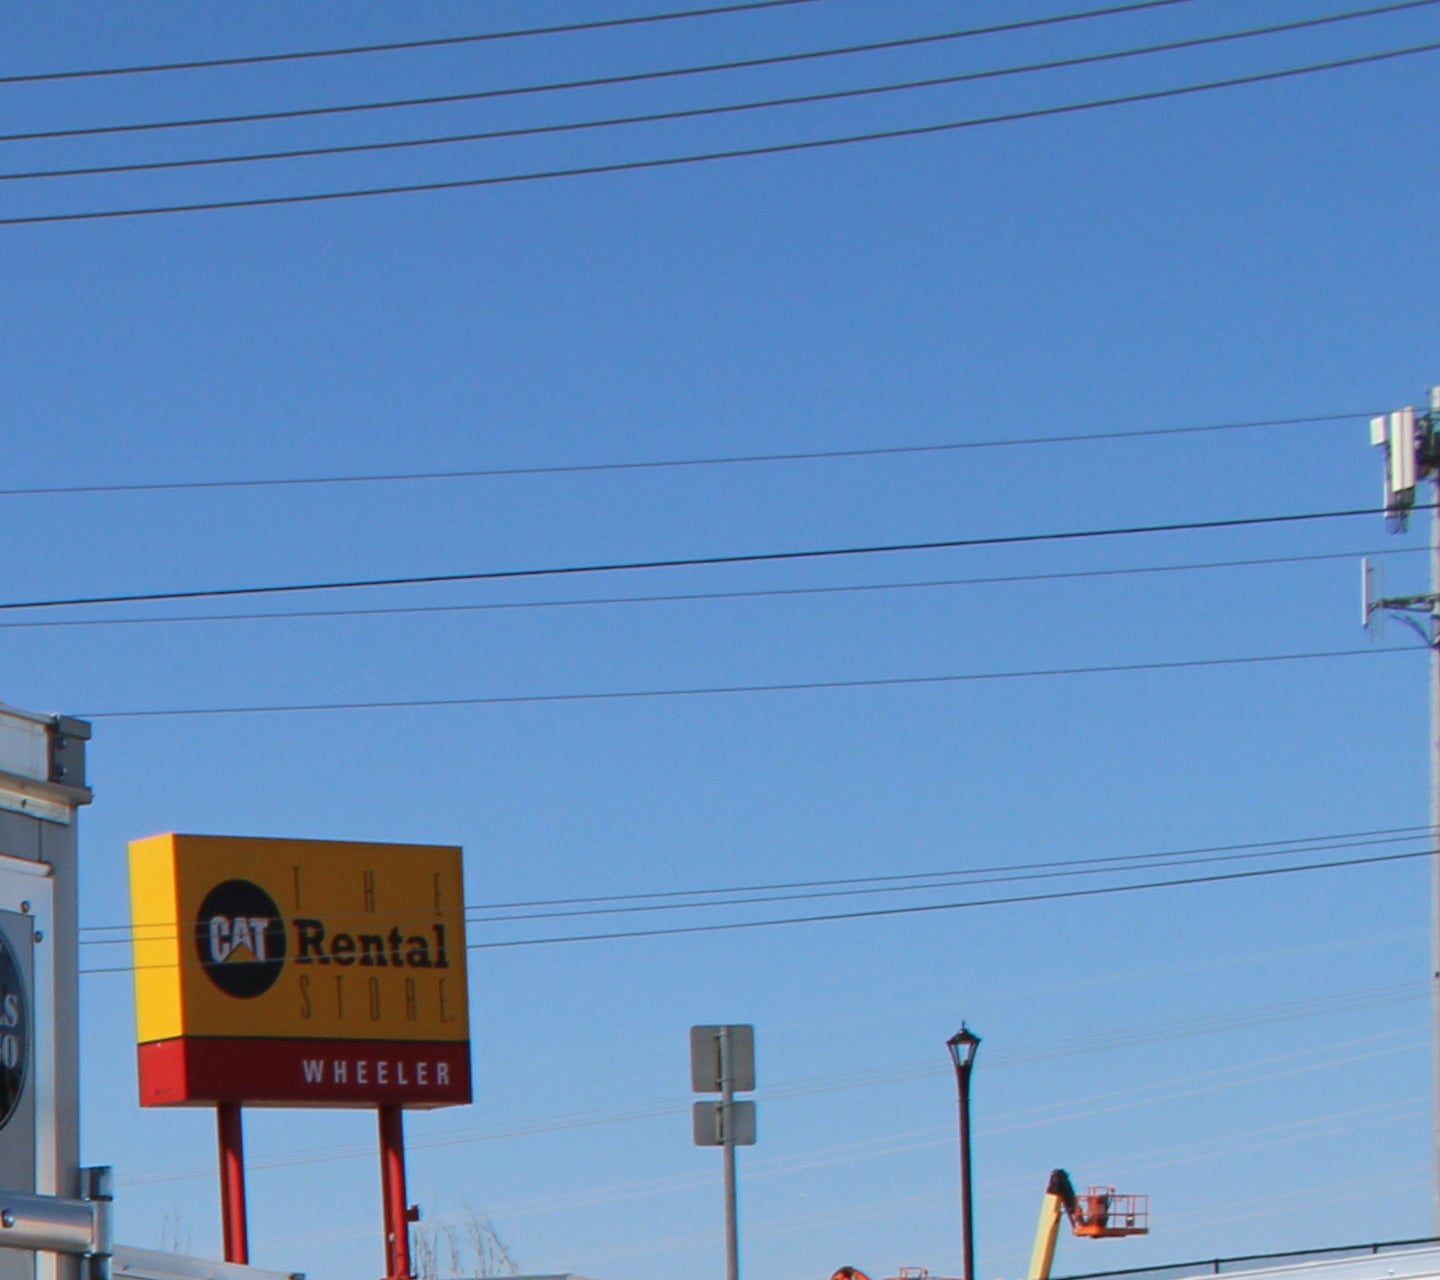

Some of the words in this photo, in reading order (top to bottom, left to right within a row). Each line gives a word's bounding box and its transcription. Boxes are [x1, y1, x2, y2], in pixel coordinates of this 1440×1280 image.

[292, 866, 442, 917] THE
[209, 916, 271, 964] CAT
[293, 918, 449, 969] Rental
[300, 975, 451, 1023] STORE
[303, 1059, 450, 1085] WHEELER
